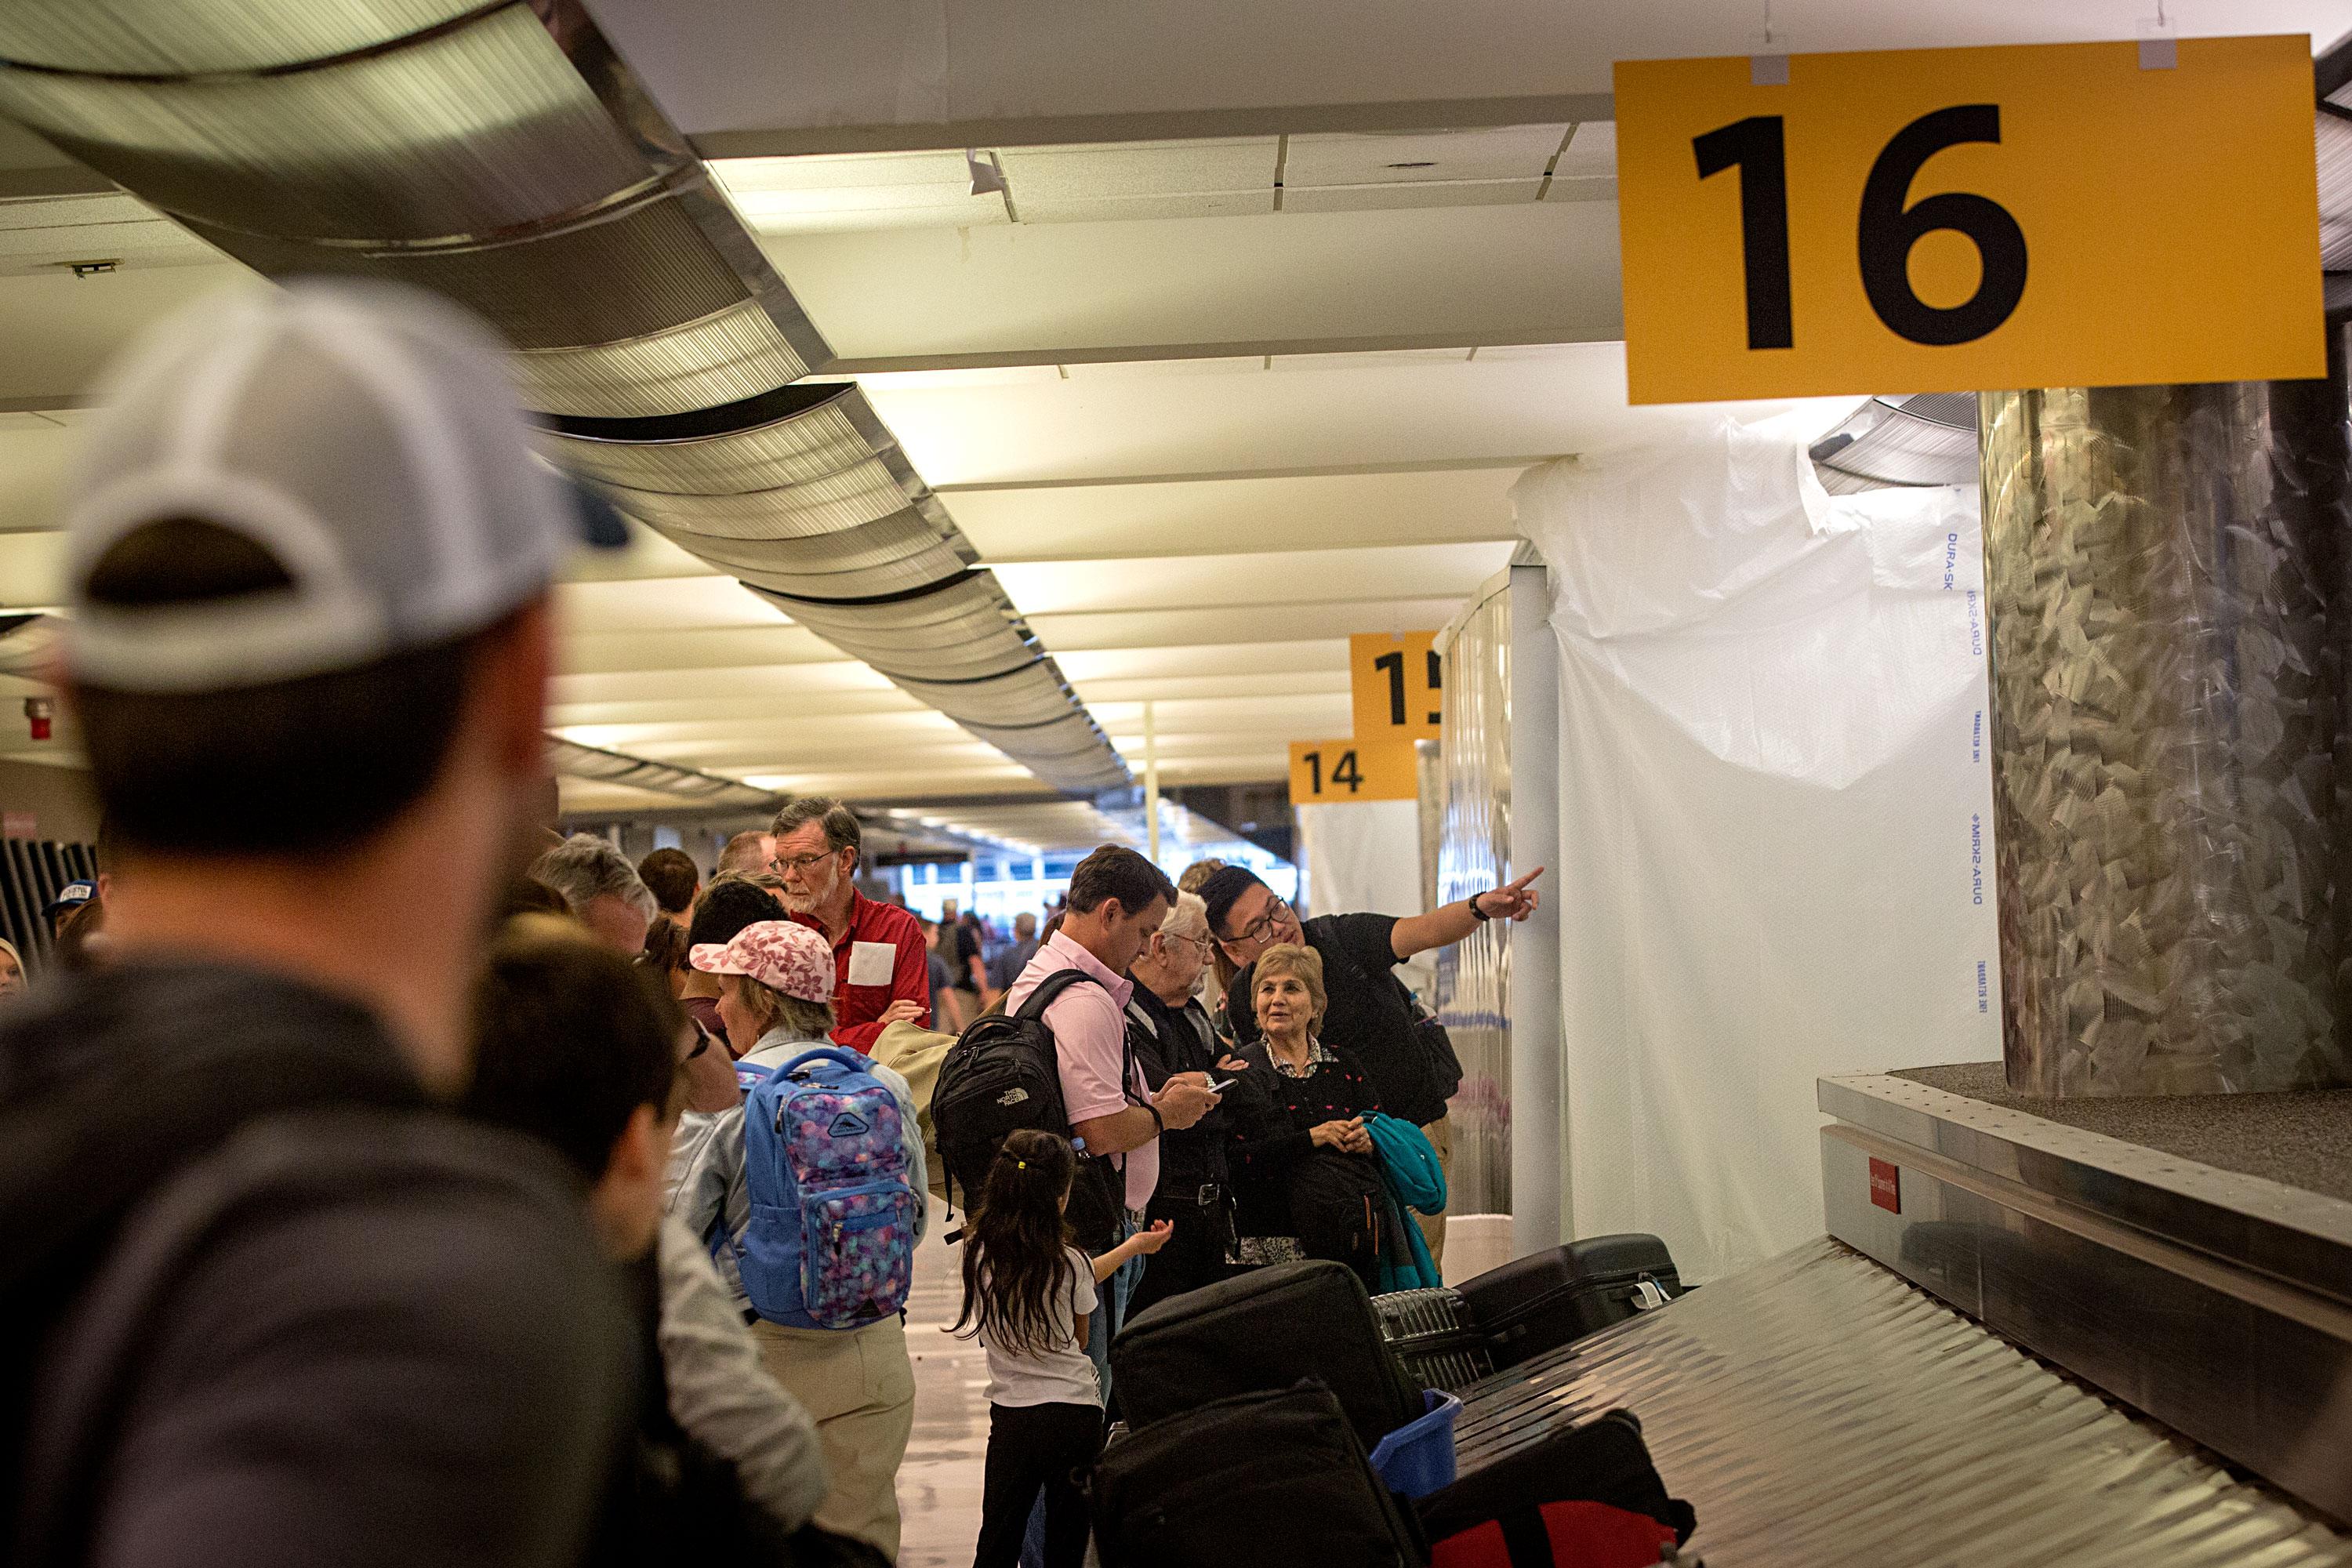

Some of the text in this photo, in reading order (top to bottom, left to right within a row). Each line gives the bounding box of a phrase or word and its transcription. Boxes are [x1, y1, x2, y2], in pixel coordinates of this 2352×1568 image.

[1692, 103, 2029, 350] 16
[1303, 750, 1365, 795] 14
[996, 1094, 1018, 1104] NORTH
[1004, 1097, 1020, 1107] FACE
